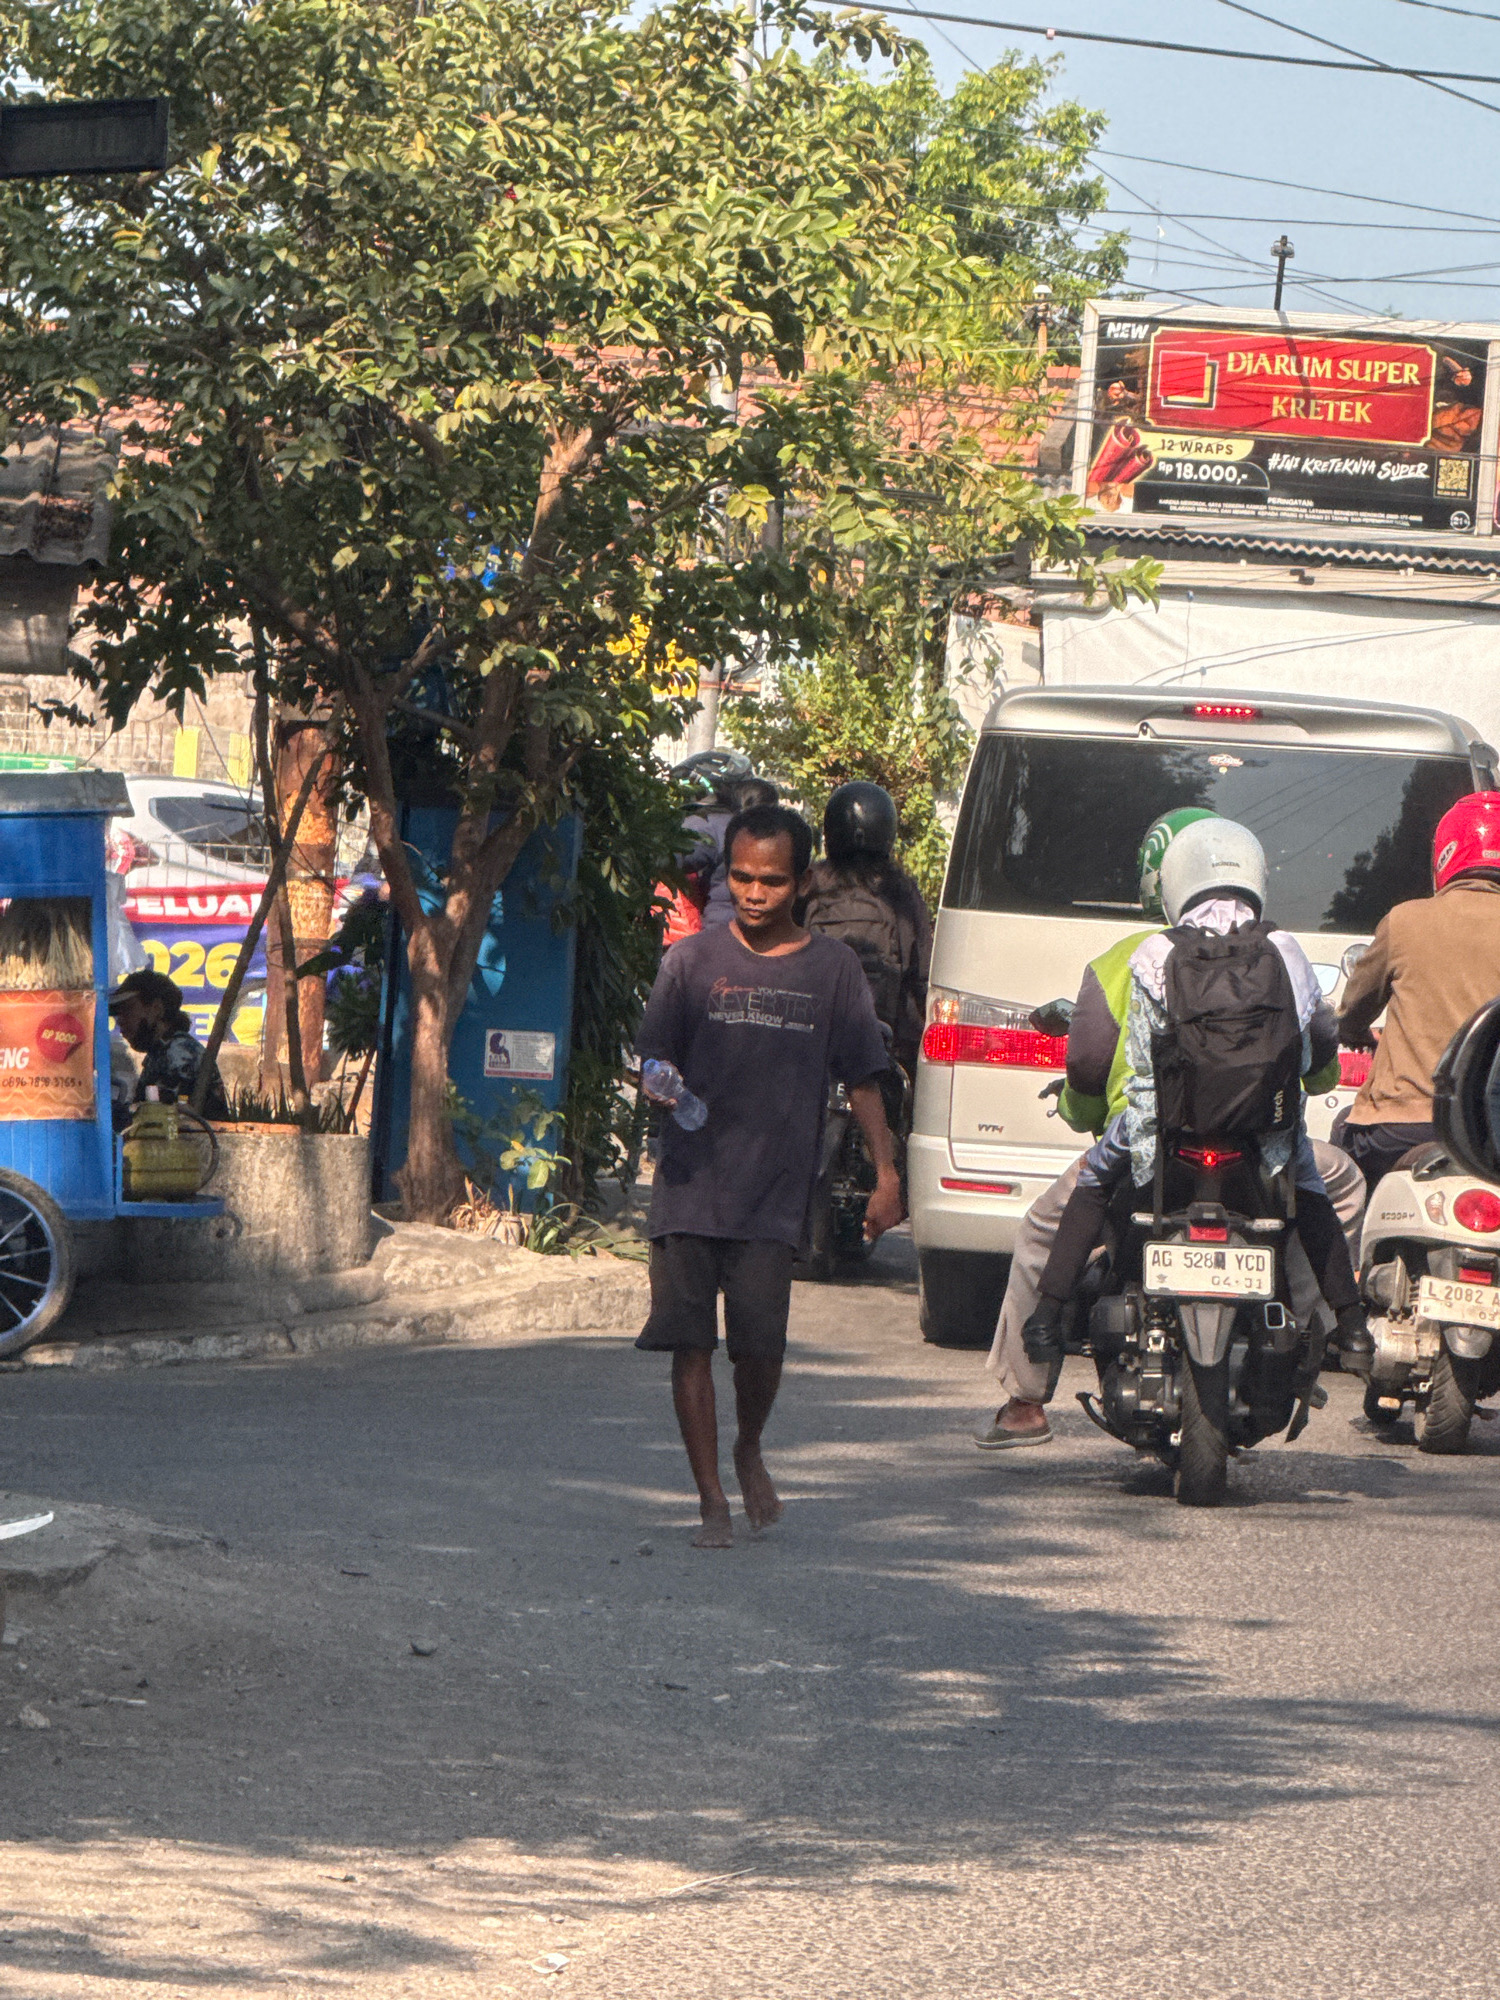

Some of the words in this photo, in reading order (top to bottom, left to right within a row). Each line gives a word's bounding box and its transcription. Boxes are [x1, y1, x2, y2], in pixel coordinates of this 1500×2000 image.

[1107, 322, 1149, 339] NEW
[1226, 351, 1333, 379] DJARUM
[1337, 359, 1421, 385] SUPER
[1271, 396, 1372, 424] KRETEK
[1161, 439, 1175, 451] 12
[1180, 440, 1234, 455] WRAPS
[1158, 461, 1173, 475] Rp
[1175, 462, 1248, 485] 18.000,-
[1301, 457, 1377, 476] KRETEKNYA
[1377, 461, 1430, 482] SUPER
[1212, 861, 1240, 869] HONDA
[708, 1011, 745, 1021] NEVER
[747, 1012, 783, 1023] KNOW
[41, 1029, 55, 1040] RP
[55, 1031, 77, 1043] 1000
[1152, 1250, 1172, 1267] AG
[1235, 1254, 1266, 1271] YCD
[1428, 1281, 1436, 1297] L
[1445, 1285, 1484, 1305] 2082
